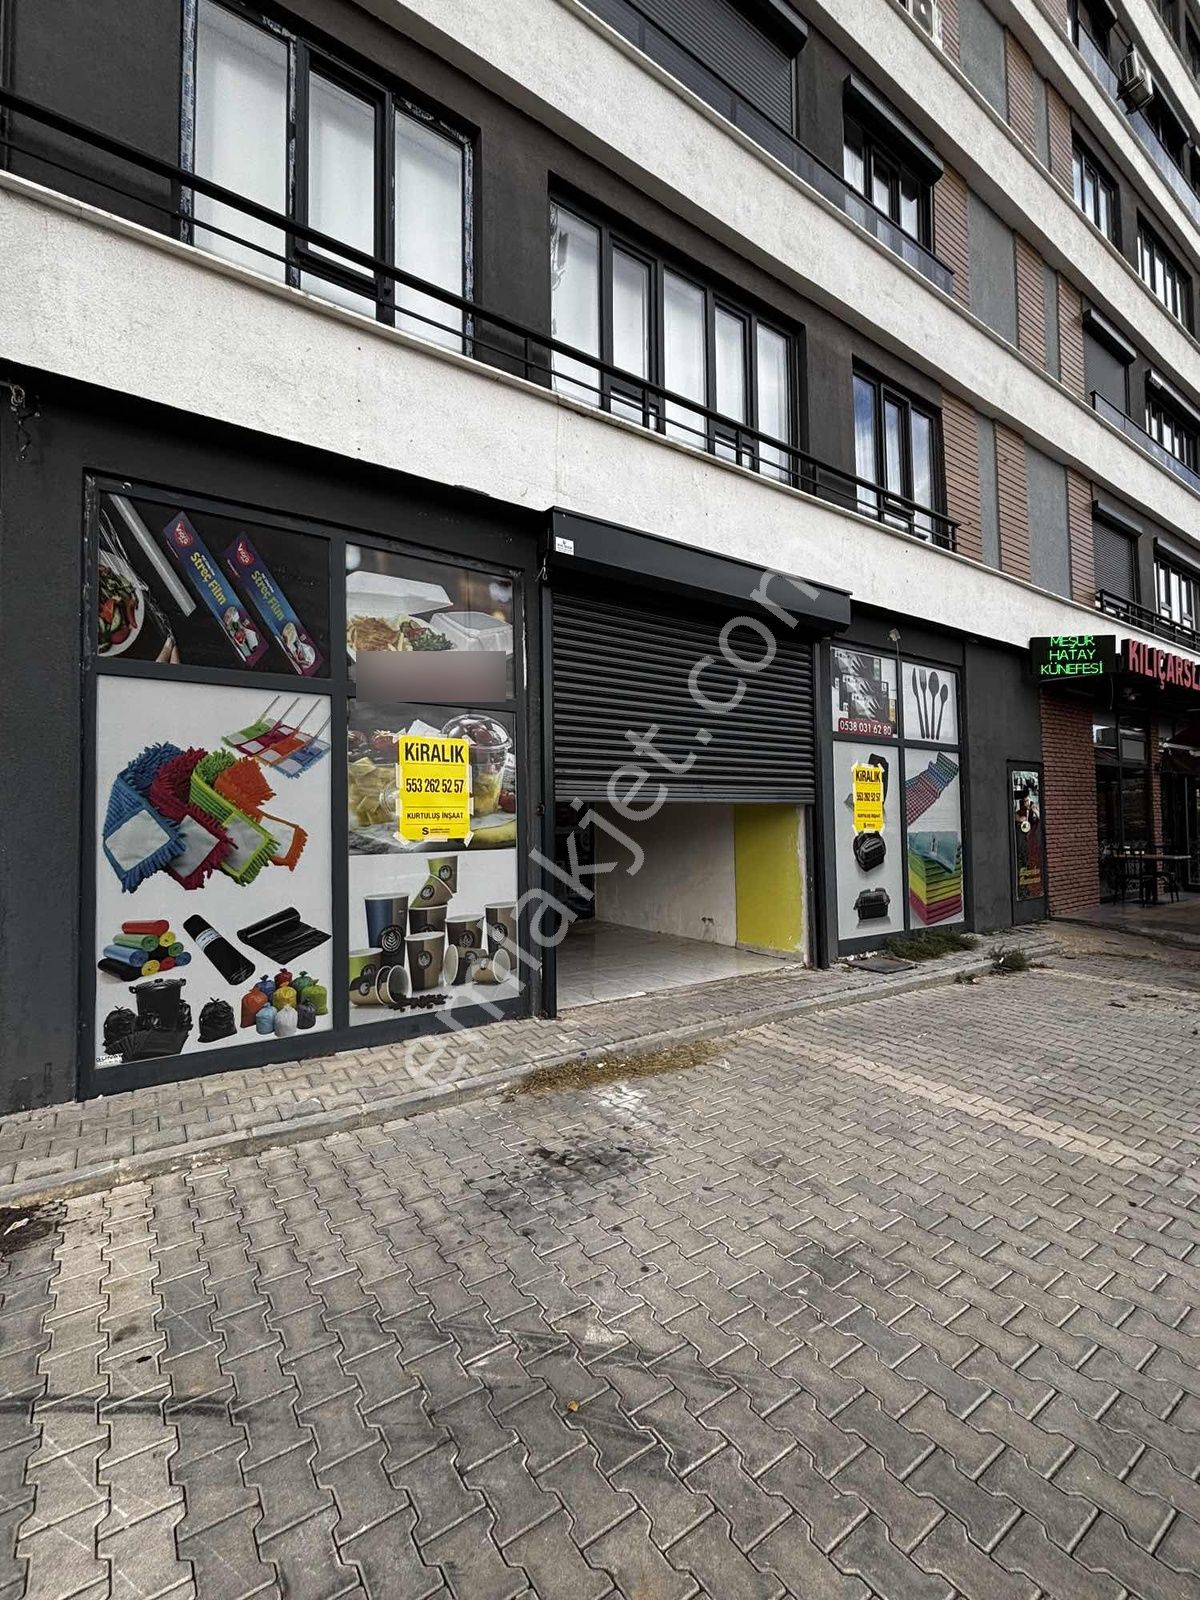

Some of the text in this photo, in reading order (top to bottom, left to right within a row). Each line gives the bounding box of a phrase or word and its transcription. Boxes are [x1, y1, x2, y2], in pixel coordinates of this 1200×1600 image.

[208, 579, 226, 605] Film
[1049, 649, 1096, 661] HATAY
[1040, 660, 1104, 675] KÜNEFESİ
[859, 721, 872, 734] 031
[873, 724, 882, 735] 62
[406, 778, 464, 793] 553 262 52 57
[406, 812, 441, 821] KURTULUŞ
[422, 827, 430, 835] S
